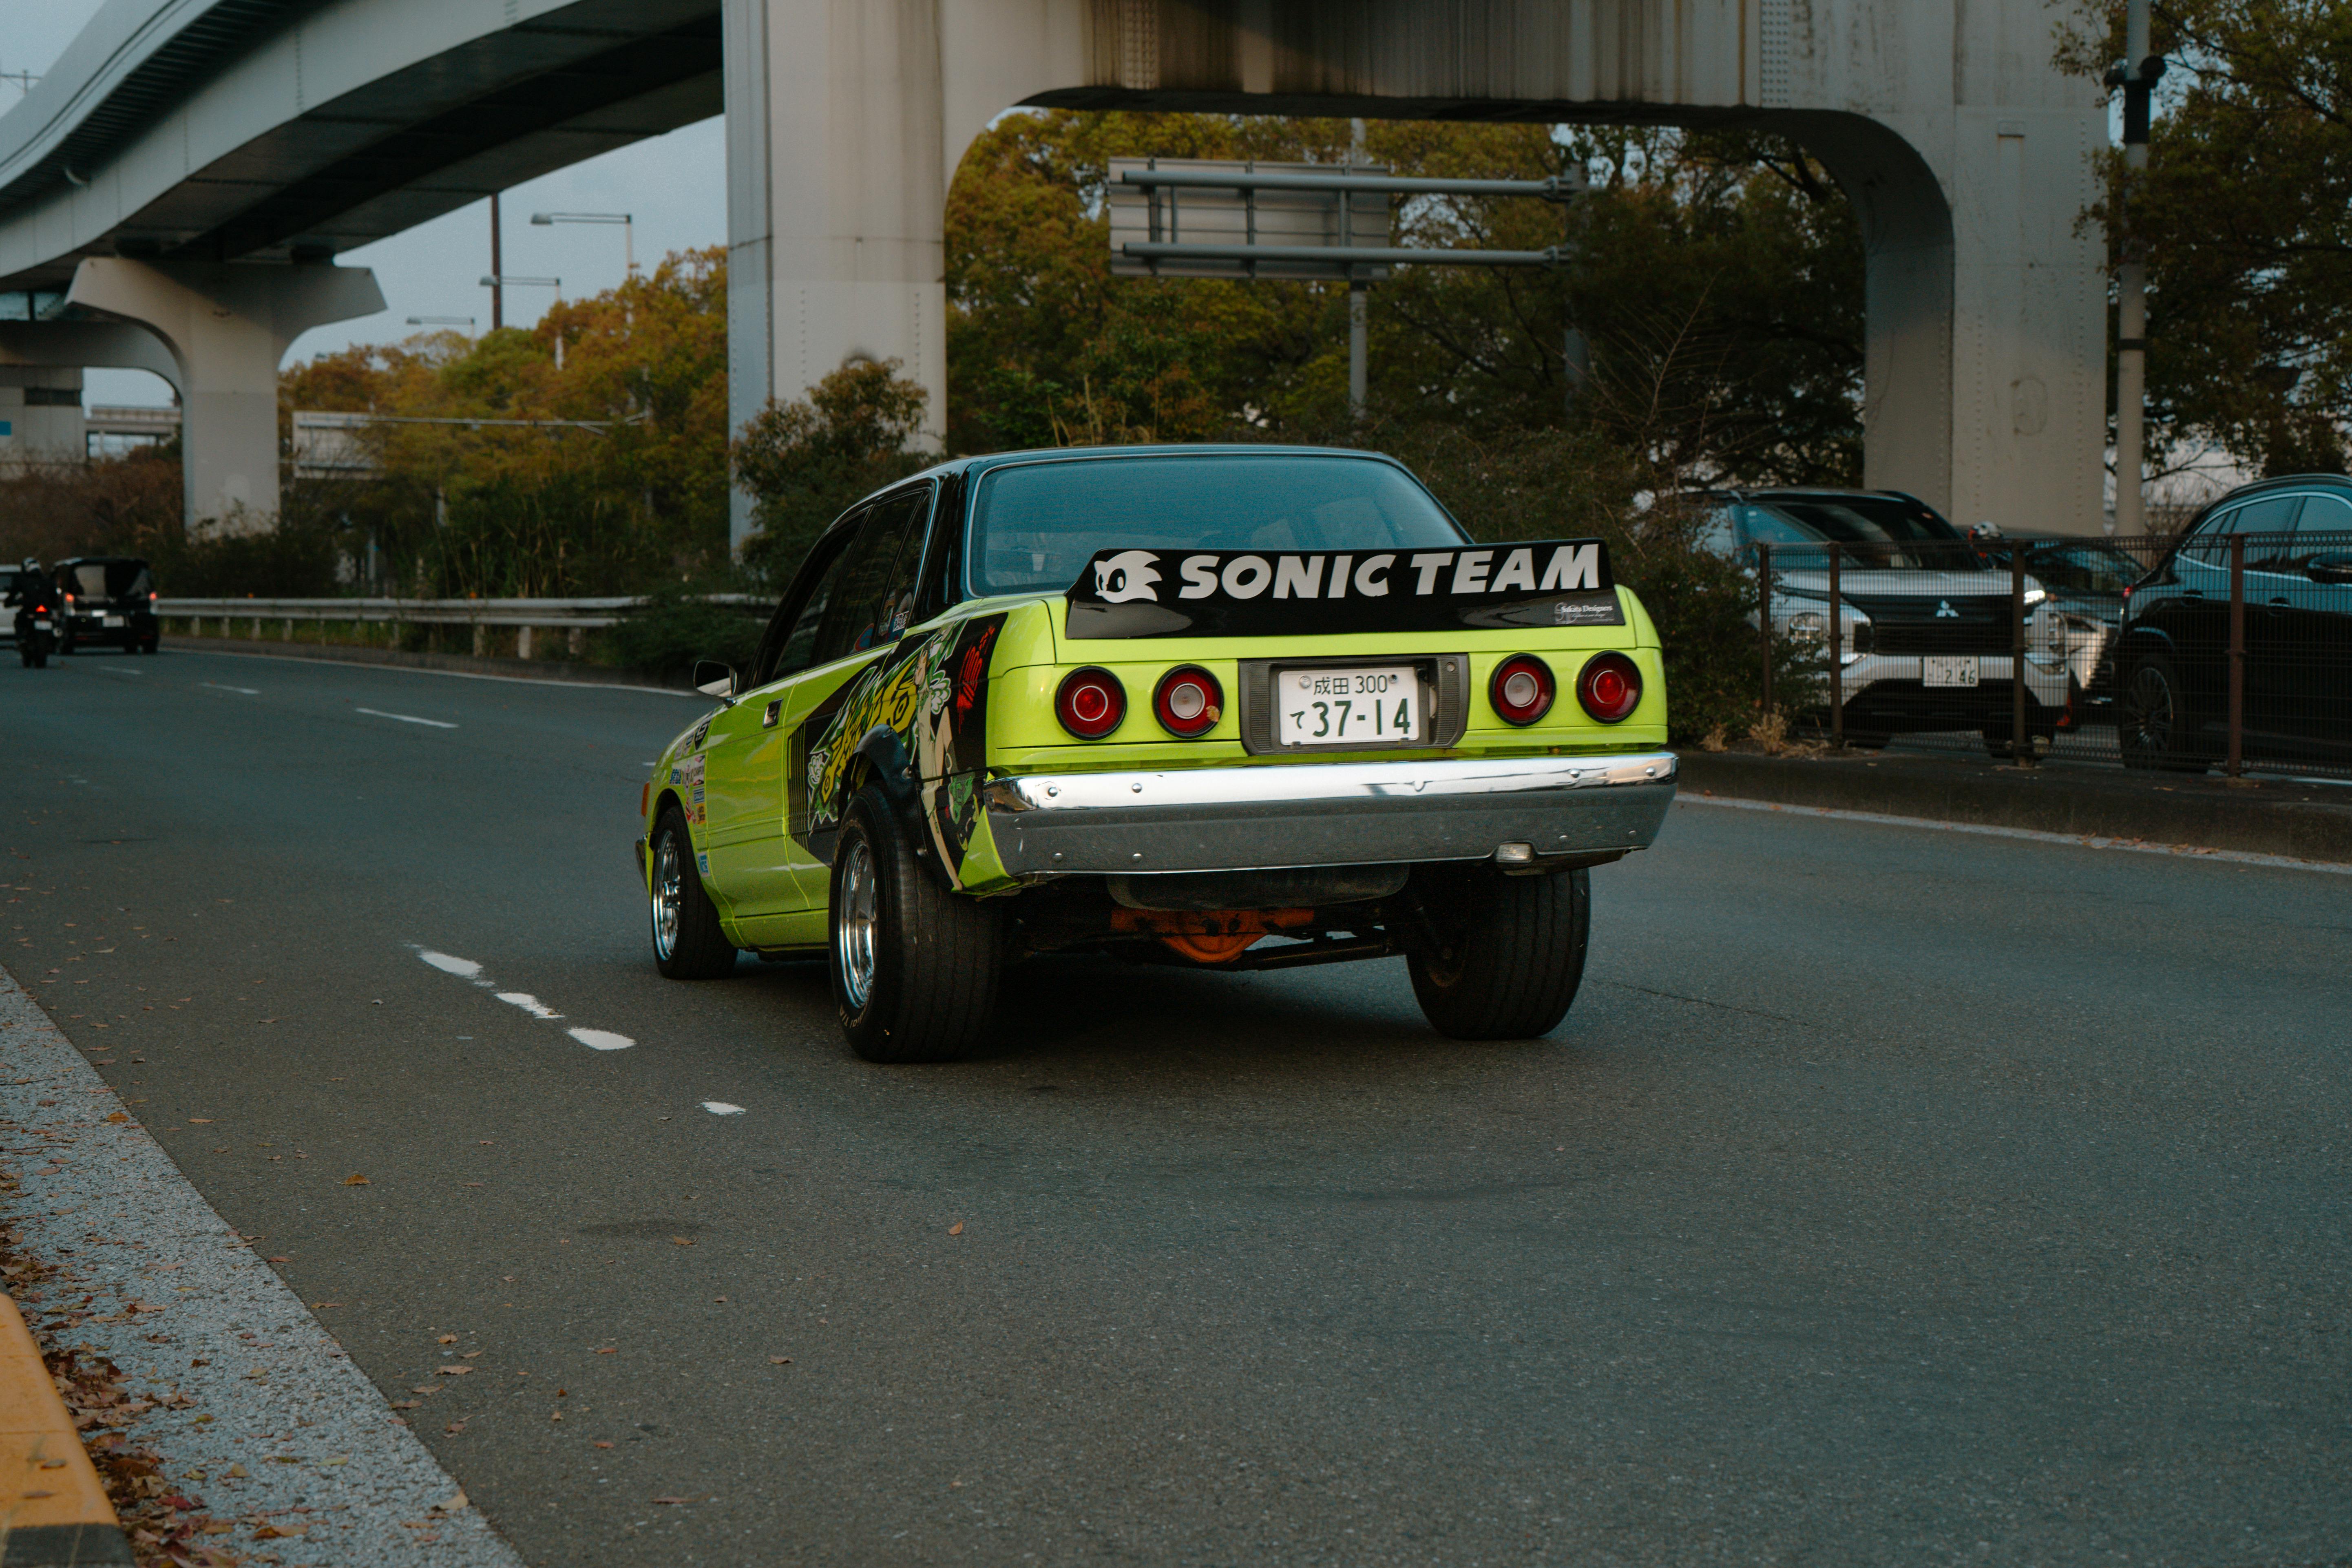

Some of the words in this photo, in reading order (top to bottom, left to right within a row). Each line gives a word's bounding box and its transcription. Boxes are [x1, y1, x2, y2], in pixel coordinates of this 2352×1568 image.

[1178, 554, 1397, 599] SONIC
[1410, 544, 1600, 595] TEAM
[1582, 605, 1613, 613] Designers
[1313, 677, 1349, 695] 成田
[1355, 675, 1387, 694] 300
[1290, 711, 1305, 729] て
[1312, 698, 1410, 737] 37-14
